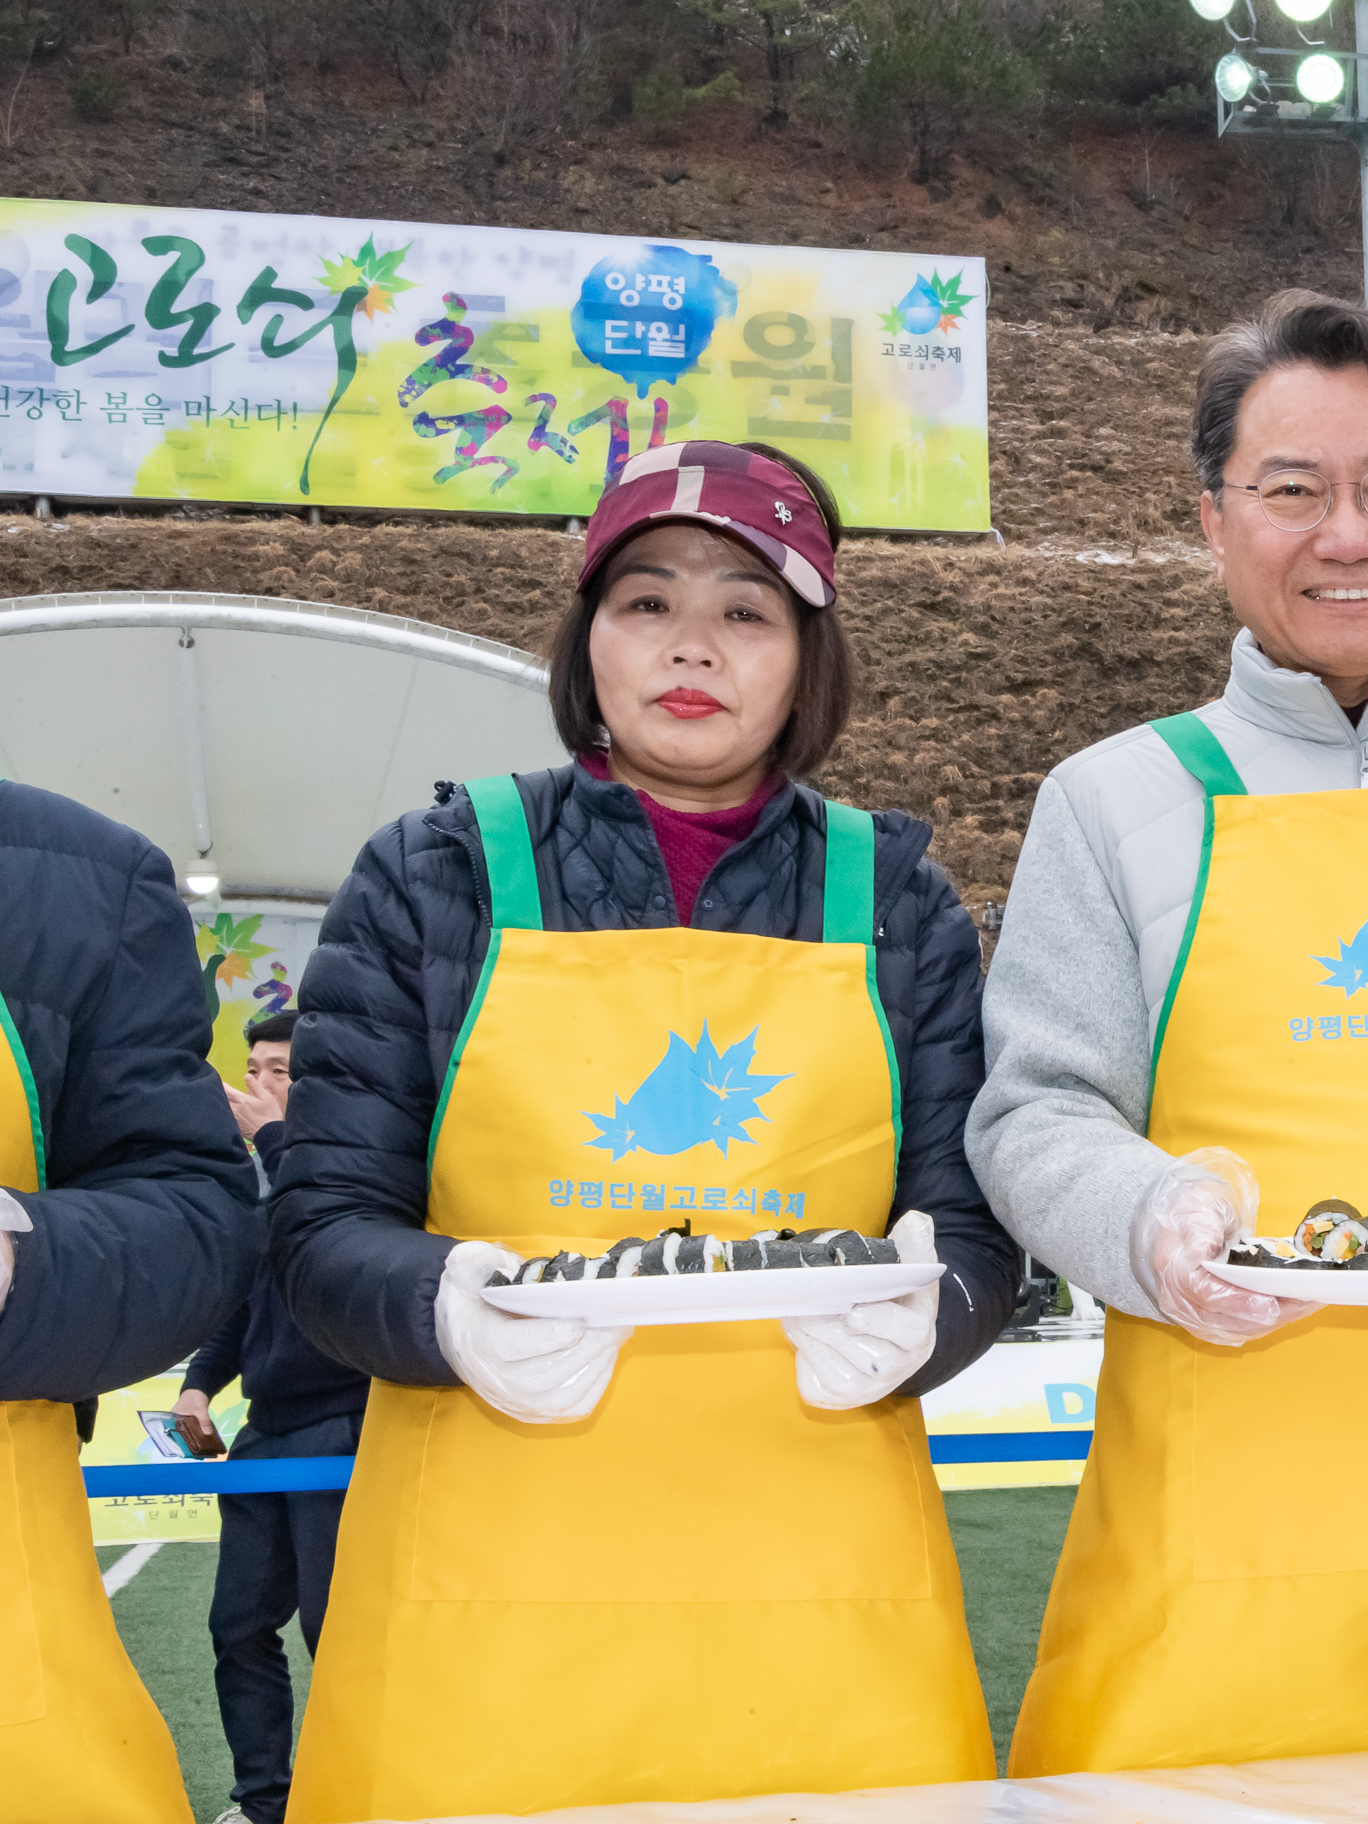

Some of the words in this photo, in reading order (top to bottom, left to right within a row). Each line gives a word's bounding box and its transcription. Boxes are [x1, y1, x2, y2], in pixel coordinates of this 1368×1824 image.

[605, 271, 686, 310] 양평
[605, 319, 686, 358] 단월
[881, 342, 962, 363] 고로쇠축제
[99, 391, 171, 426] 봄을
[182, 394, 298, 432] 마신다!
[548, 1179, 806, 1220] 양평단월고로쇠축제
